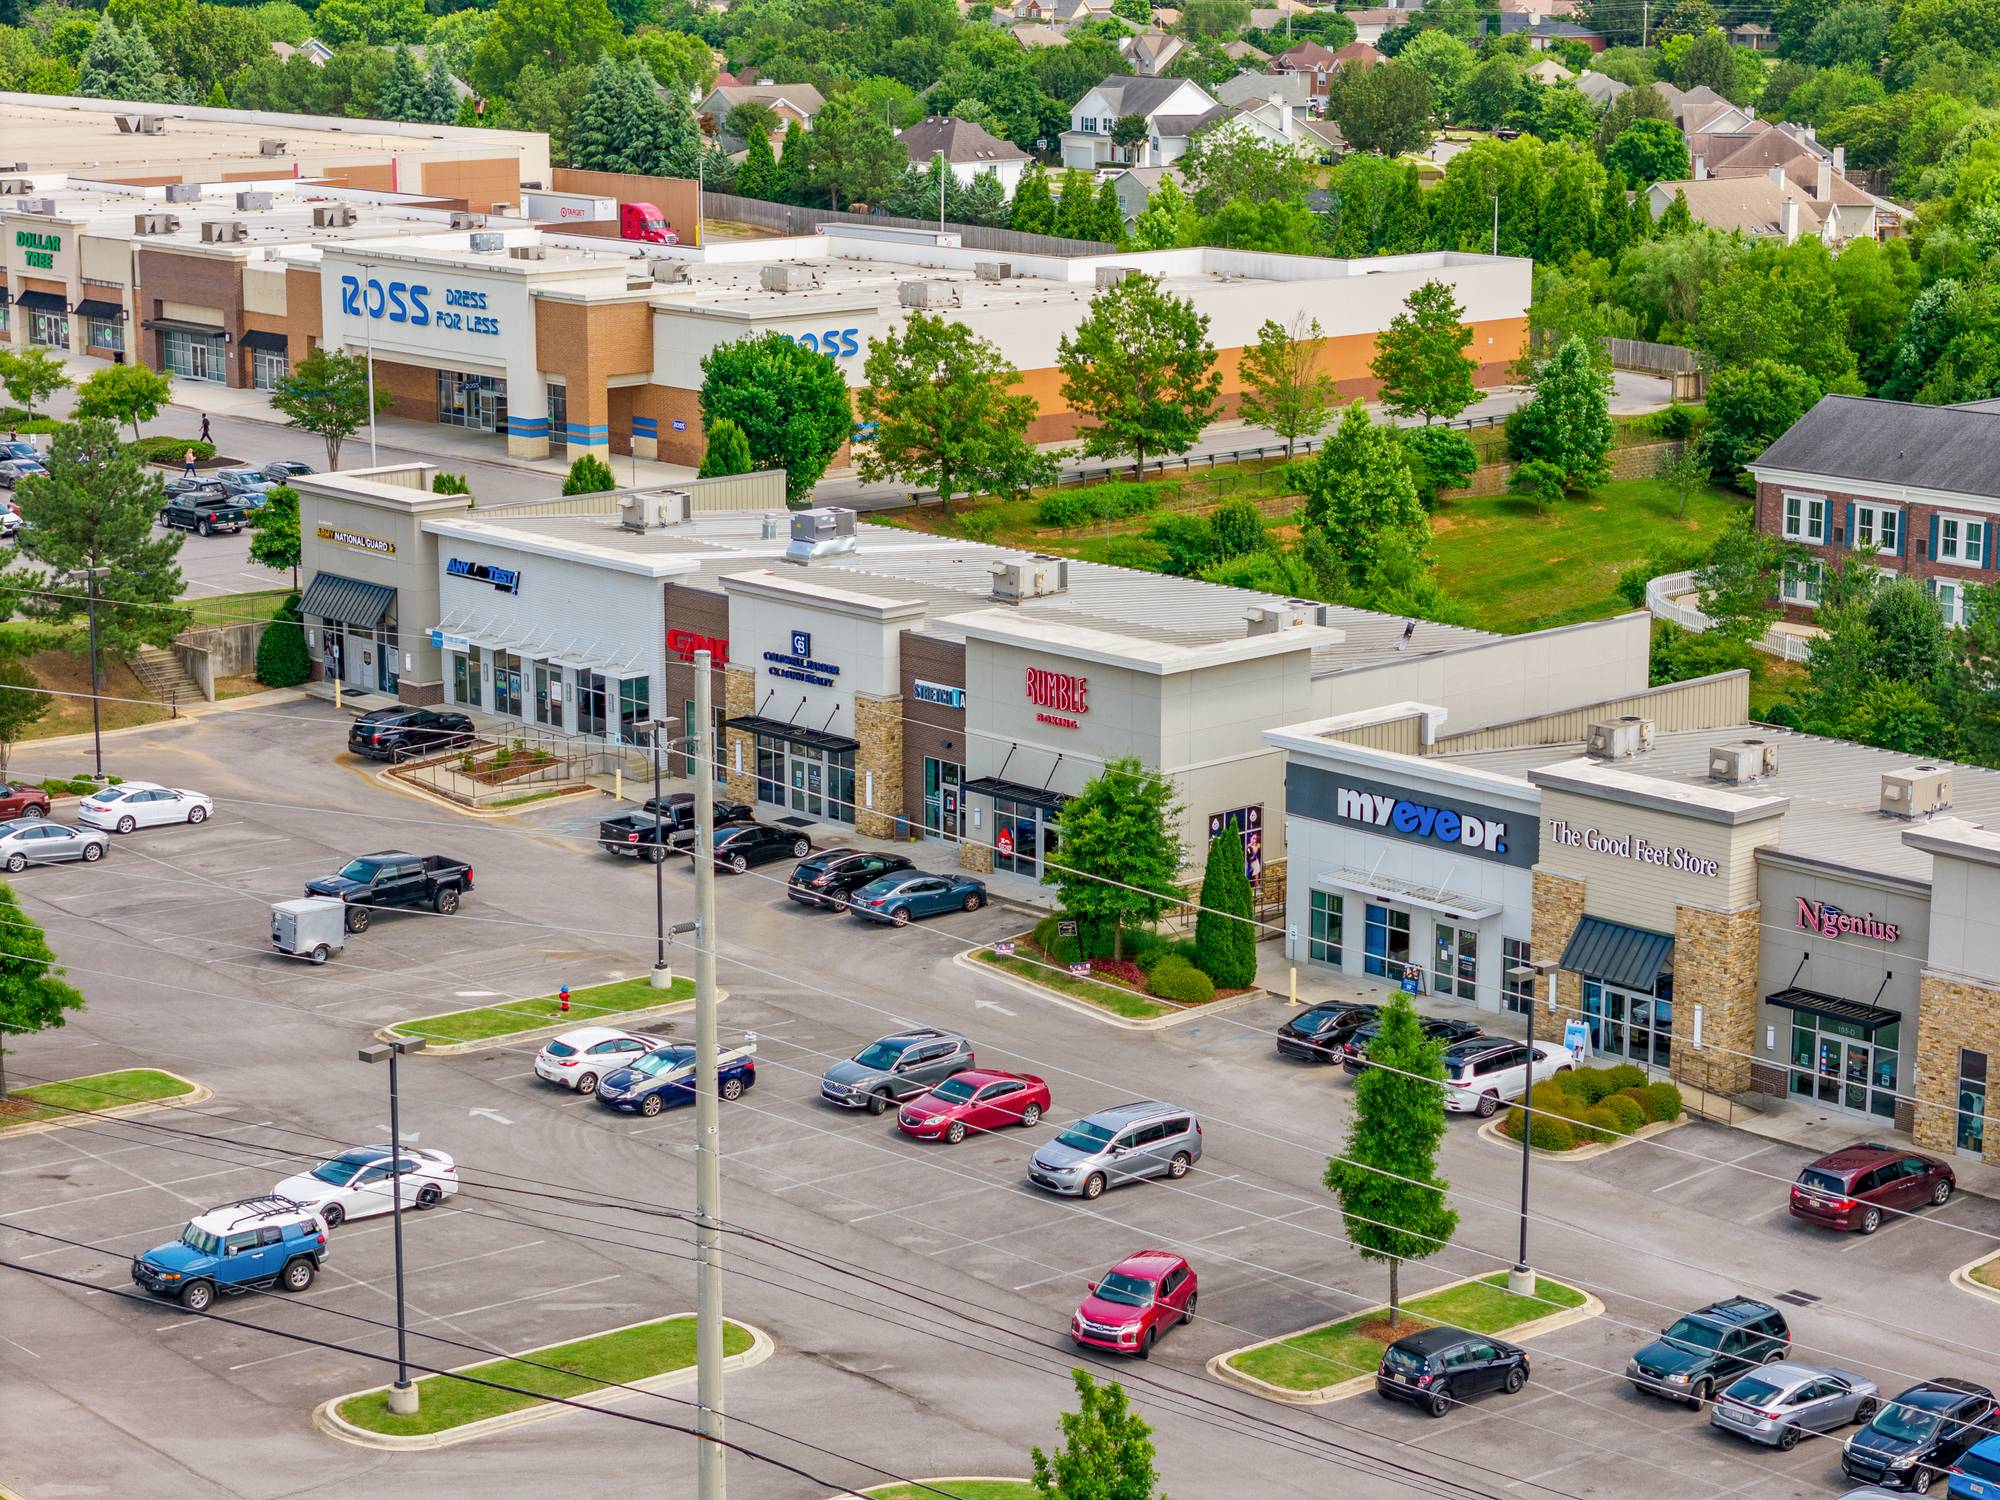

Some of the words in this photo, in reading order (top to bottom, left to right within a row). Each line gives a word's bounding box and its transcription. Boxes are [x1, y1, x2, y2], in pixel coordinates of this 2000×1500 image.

[567, 207, 585, 217] TARGET
[16, 231, 61, 252] DOLLAR
[24, 250, 54, 270] TREE
[341, 275, 431, 326] ROSS
[446, 288, 488, 310] DRESS
[436, 311, 463, 331] FOR
[466, 311, 500, 335] LESS
[780, 328, 859, 358] OSS
[334, 531, 366, 547] NATIONAL
[366, 538, 389, 552] GUARD
[447, 558, 470, 575] ANY
[487, 565, 515, 584] TEST
[667, 628, 730, 663] GNC
[806, 659, 841, 676] BANKER
[1026, 667, 1088, 713] RUMBLE
[1037, 713, 1080, 729] BOXING
[1549, 819, 1582, 847] The
[1584, 828, 1632, 858] Good
[1634, 838, 1671, 868] Feet
[1672, 847, 1719, 877] Store
[1795, 896, 1900, 943] Ngenius
[1837, 1025, 1857, 1036] 105-D
